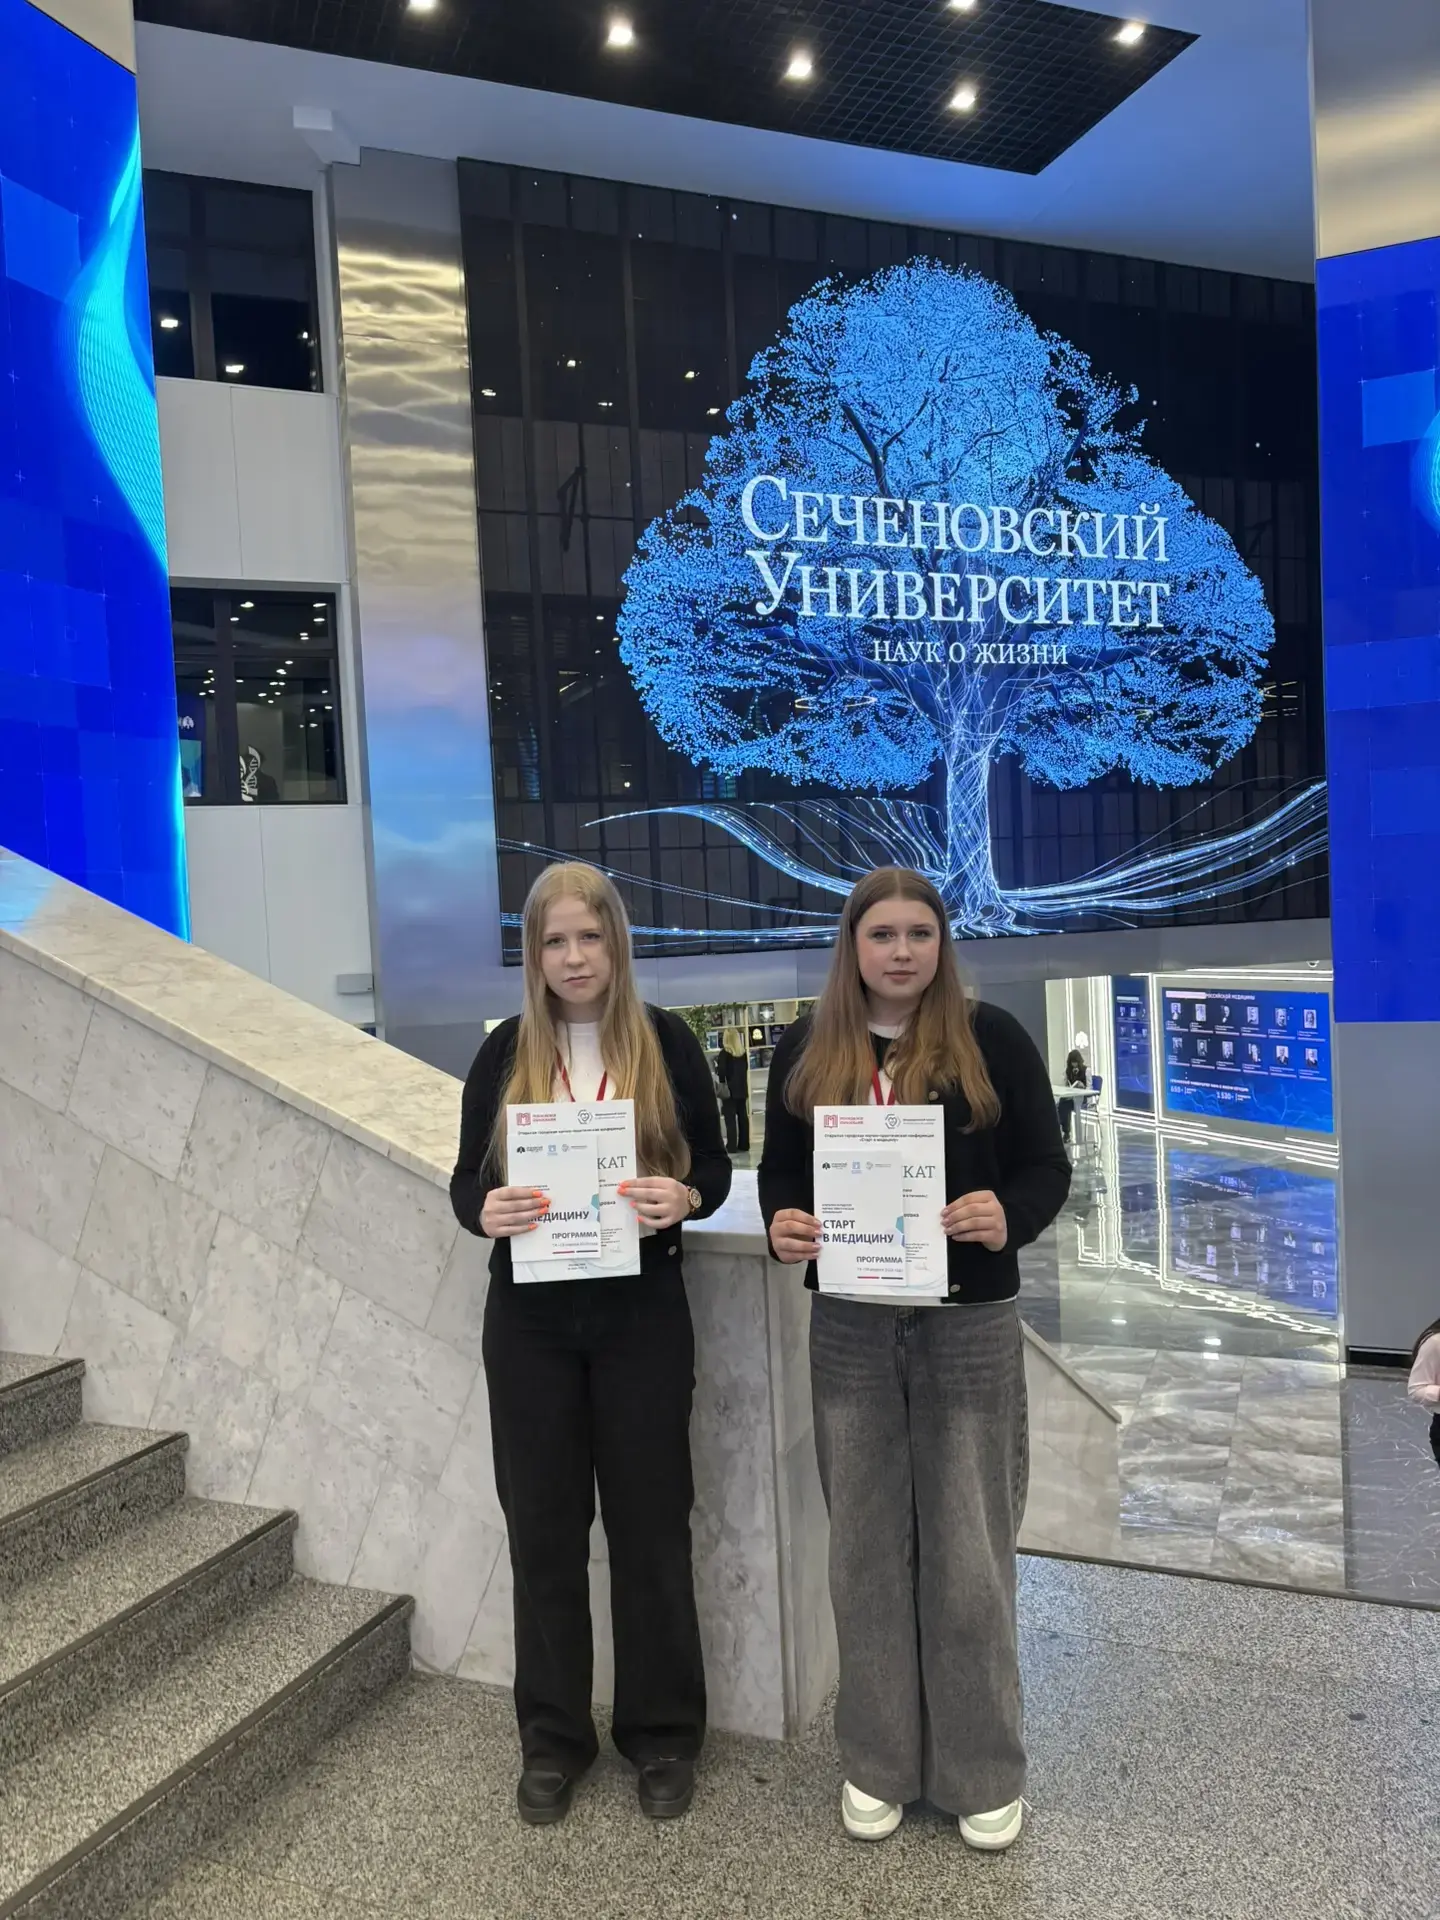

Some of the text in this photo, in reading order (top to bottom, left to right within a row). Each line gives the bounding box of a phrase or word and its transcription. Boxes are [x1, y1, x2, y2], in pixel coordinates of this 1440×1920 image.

[745, 549, 1171, 628] УНИВЕРСИТЕТ
[873, 639, 1069, 665] НАУК О ЖИЗНИ
[823, 1220, 856, 1229] СТАРТ
[552, 1231, 598, 1240] ПРОГРАММА
[823, 1233, 894, 1245] В МЕДИЦИНУ
[856, 1256, 903, 1264] ПРОГРАММА
